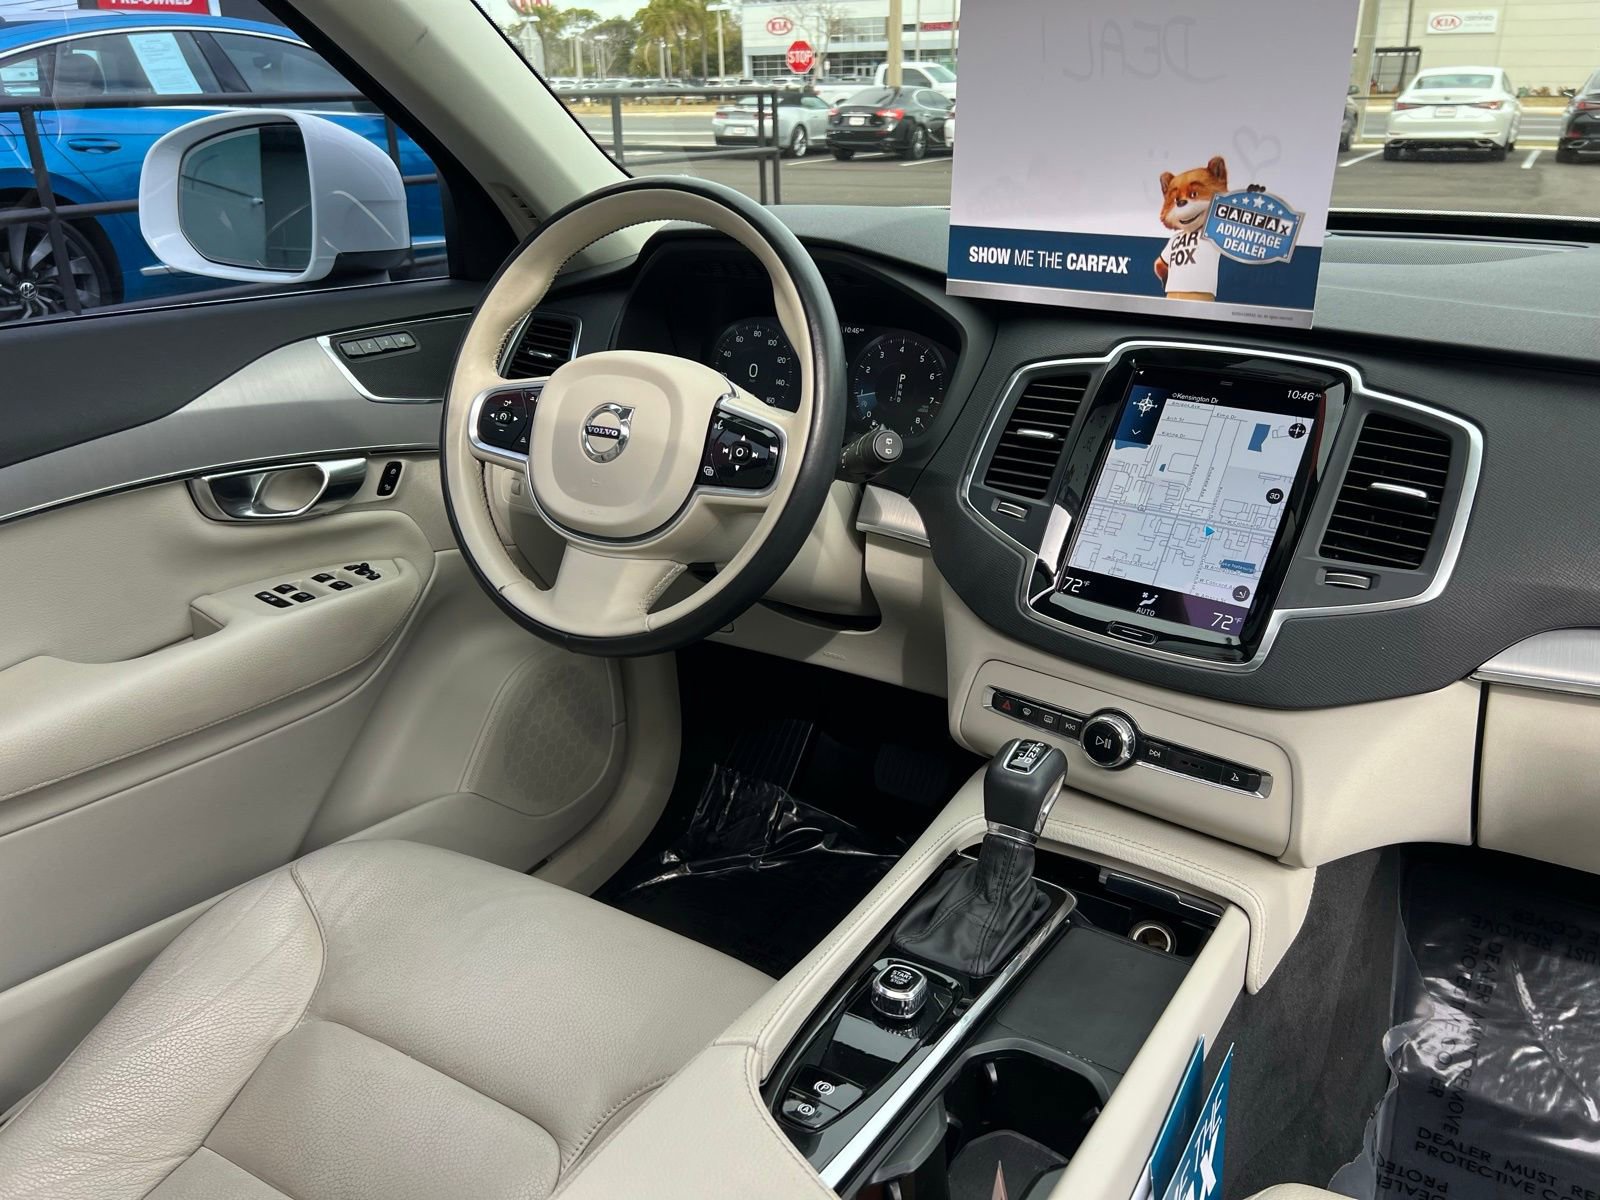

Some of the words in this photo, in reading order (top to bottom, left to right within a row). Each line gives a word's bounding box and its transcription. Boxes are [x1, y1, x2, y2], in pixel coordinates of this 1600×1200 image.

[787, 51, 813, 64] STOP
[1216, 205, 1292, 236] CARFAX
[1171, 231, 1199, 250] CAR
[1216, 222, 1282, 249] ADVANTAGE
[1170, 248, 1197, 267] FOX
[1223, 237, 1267, 259] DEALER
[969, 245, 1011, 265] SHOW
[1014, 249, 1035, 267] ME
[1037, 250, 1063, 270] THE
[1066, 252, 1129, 274] CARFAX
[748, 363, 758, 378] 0
[900, 374, 906, 382] P
[1176, 392, 1210, 403] Kensington
[1288, 390, 1314, 401] 10:46
[588, 426, 618, 436] VOLVO
[1270, 492, 1280, 500] 3D
[1136, 607, 1155, 617] AUTO
[1565, 943, 1600, 969] UST
[1428, 1036, 1457, 1098] COER
[1415, 1141, 1536, 1195] PROTECTIVE
[1418, 1126, 1491, 1162] DEALER
[1504, 1160, 1557, 1187] MUST
[1571, 1185, 1600, 1200] RE
